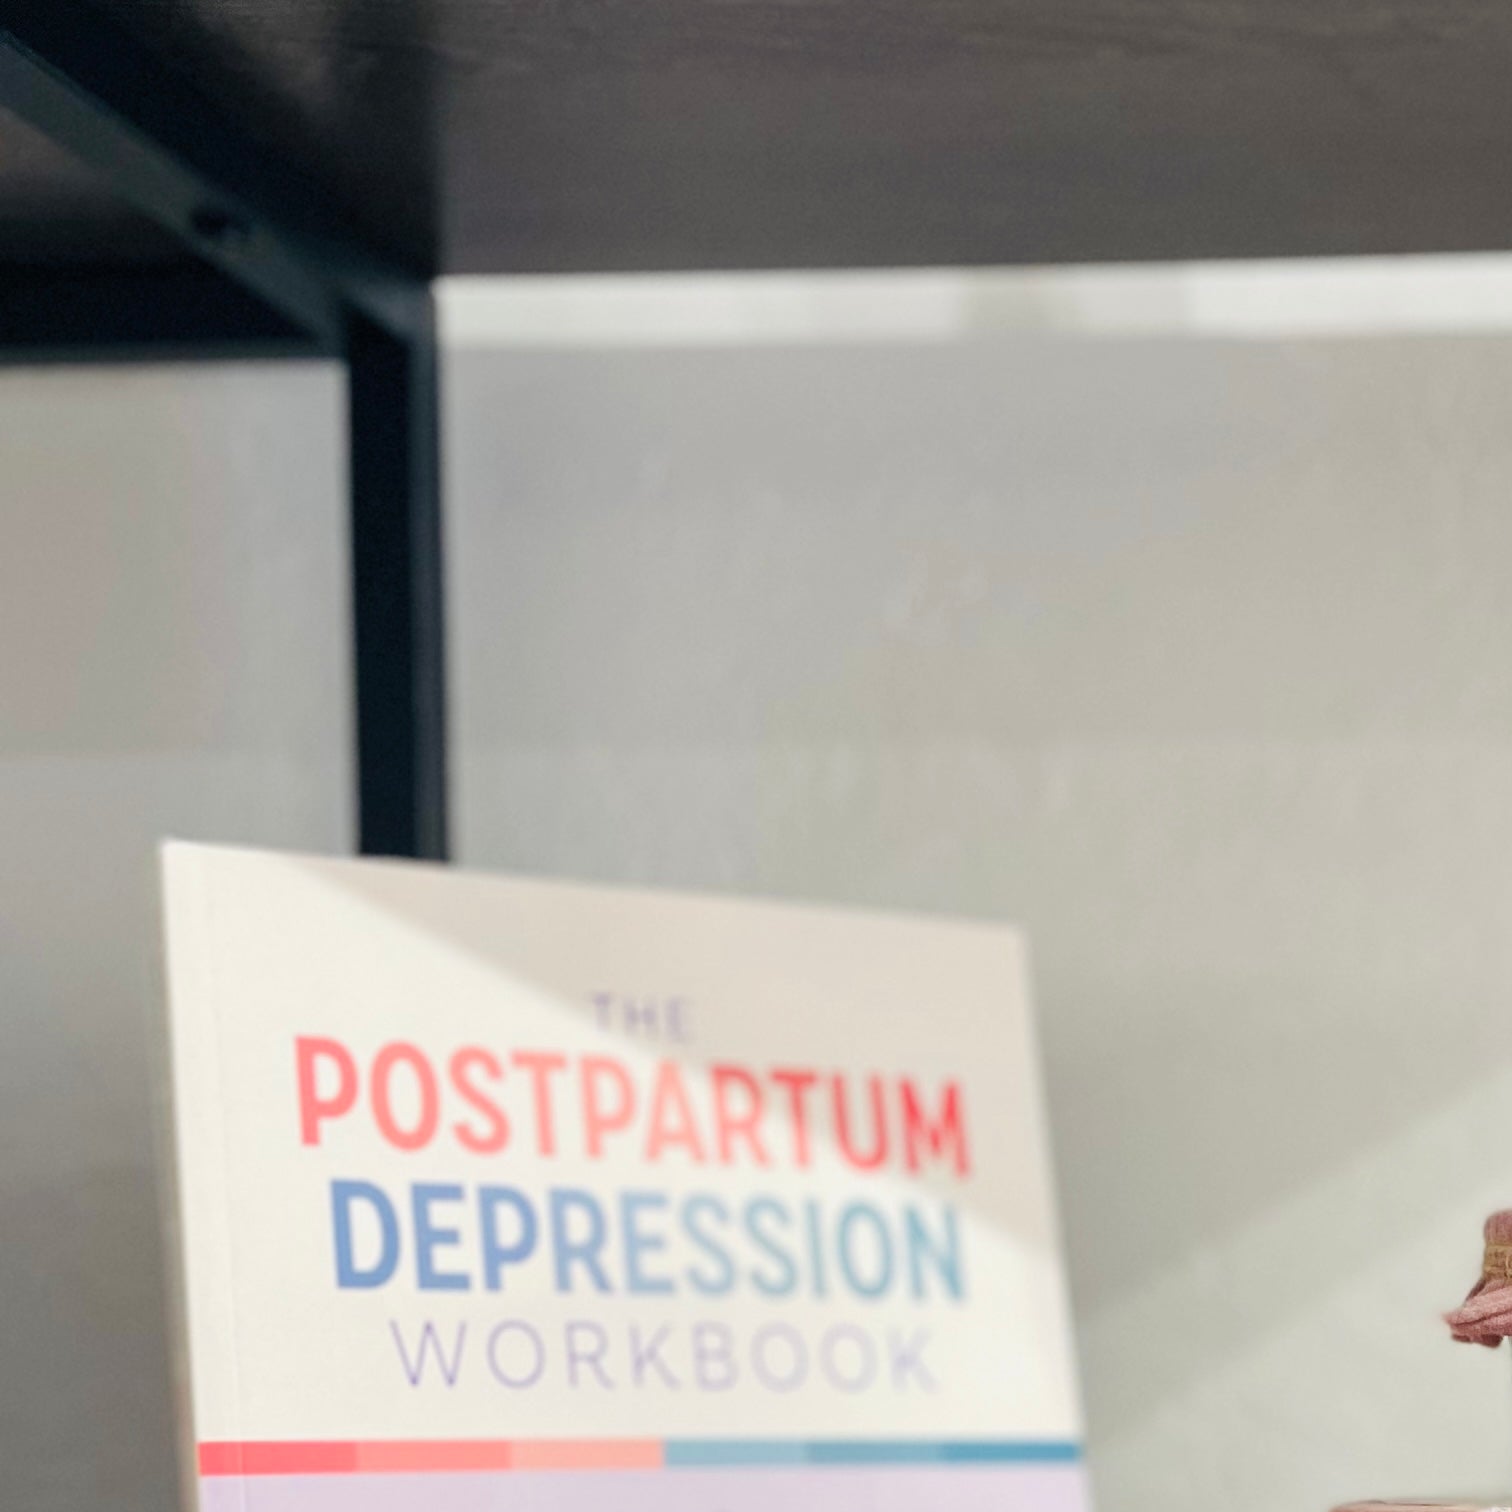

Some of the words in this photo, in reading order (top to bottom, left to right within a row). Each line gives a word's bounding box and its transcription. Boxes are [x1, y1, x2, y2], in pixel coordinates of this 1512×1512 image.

[586, 991, 693, 1044] THE
[295, 1036, 972, 1178] POSTPARTUM
[330, 1179, 967, 1303] DEPRESSION
[391, 1319, 939, 1394] WORKBOOK
